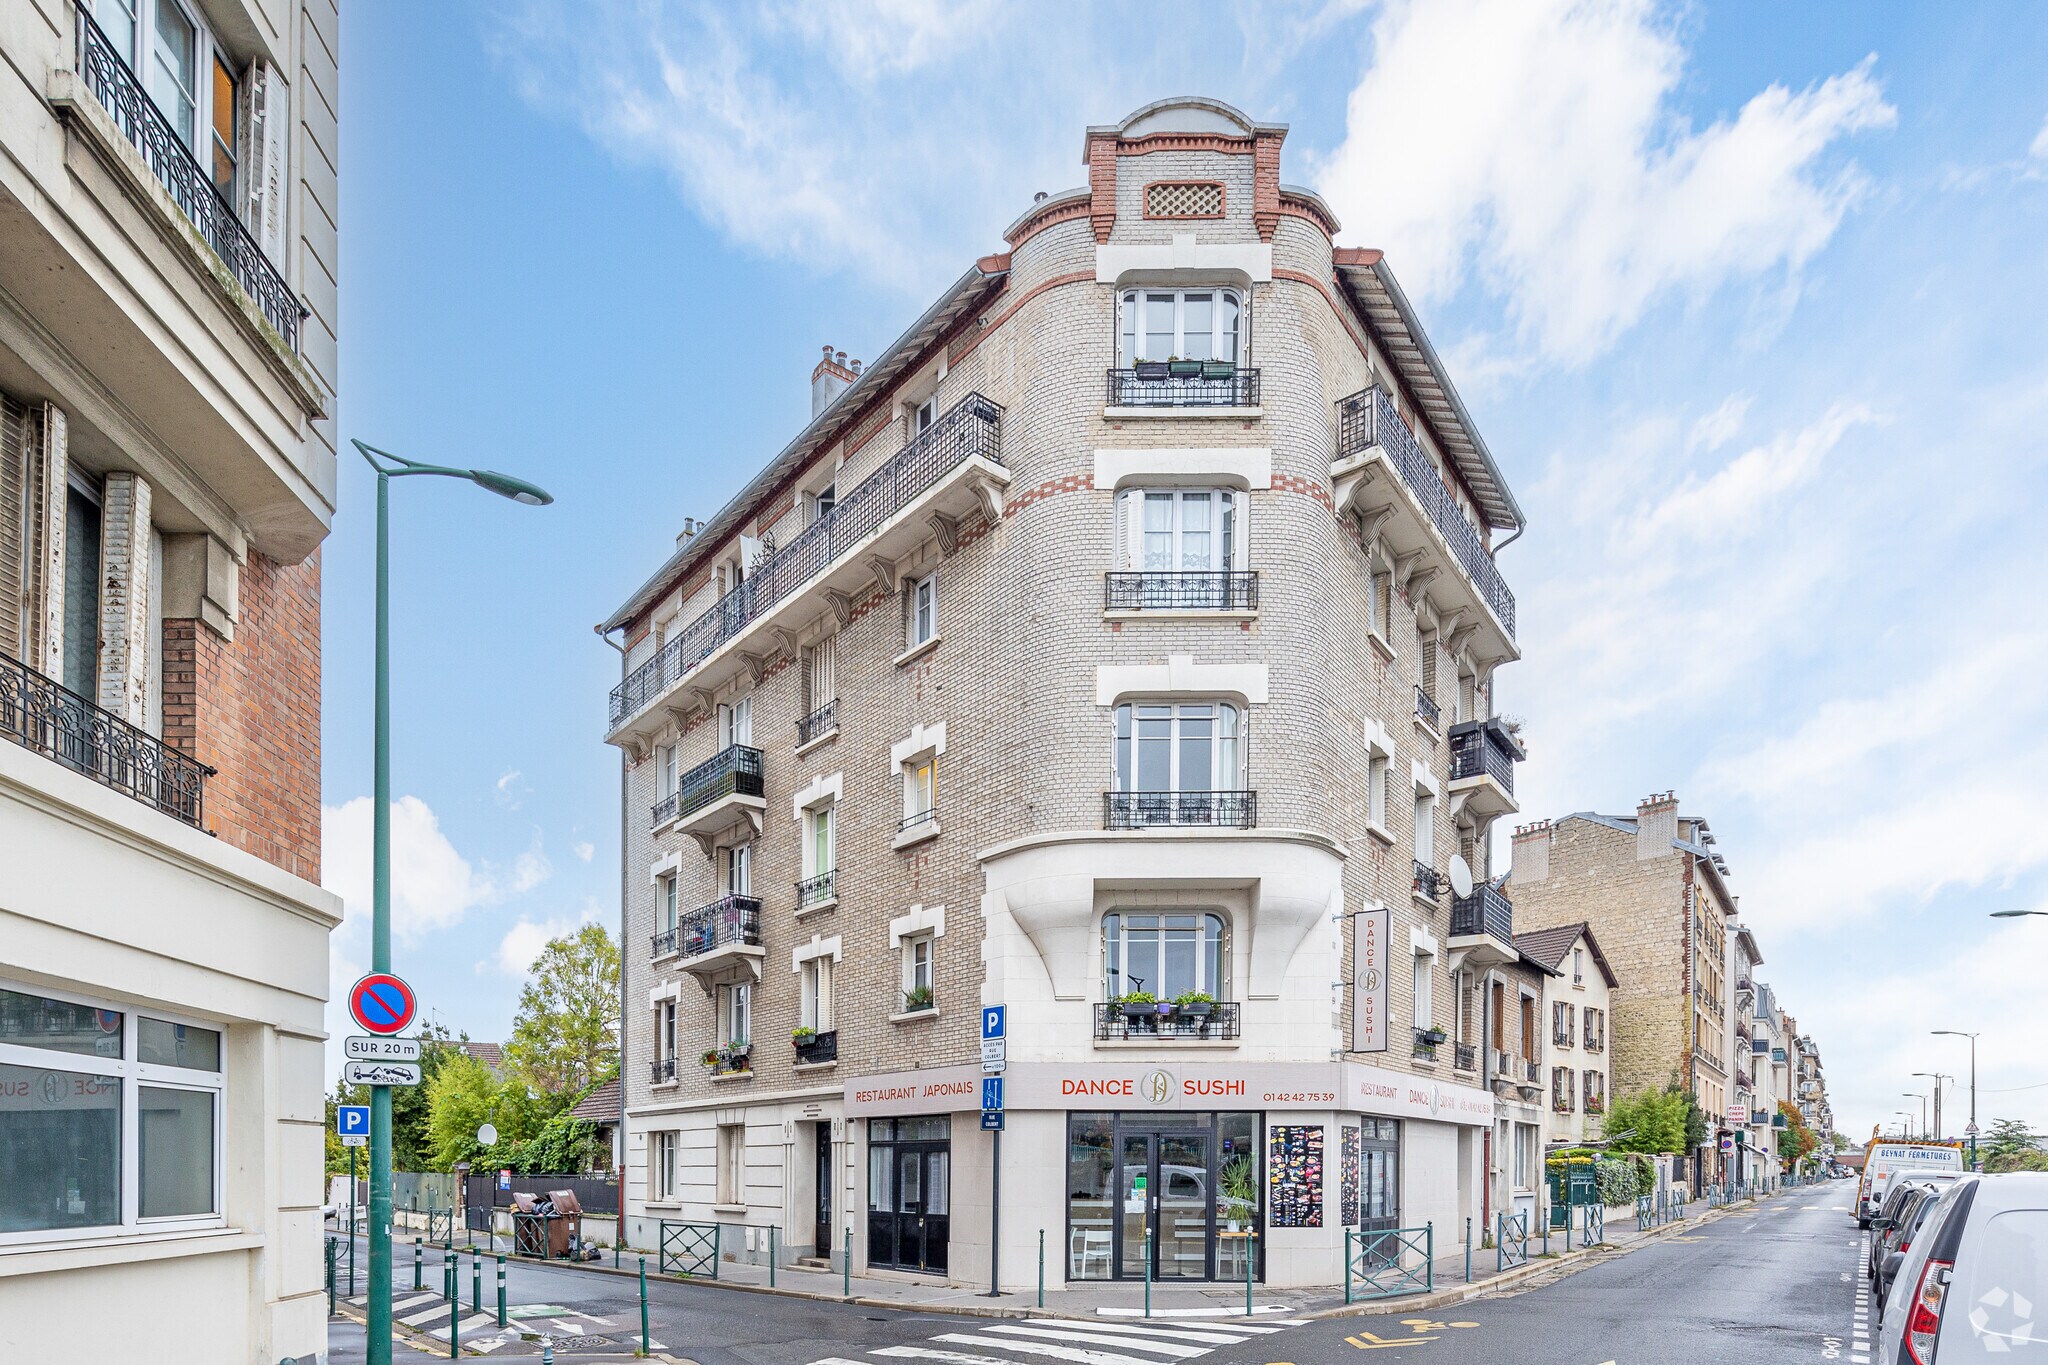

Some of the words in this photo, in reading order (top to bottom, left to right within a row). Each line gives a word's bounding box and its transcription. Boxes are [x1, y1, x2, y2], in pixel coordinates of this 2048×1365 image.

[1366, 920, 1375, 967] DANCE
[987, 1012, 999, 1033] P
[1365, 996, 1373, 1044] SUSHI
[351, 1042, 378, 1053] SUR
[384, 1044, 401, 1054] 20
[403, 1046, 415, 1055] m
[856, 1086, 917, 1103] RESTAURANT
[922, 1081, 974, 1098] JAPONAIS
[1062, 1079, 1134, 1095] DANCE
[1183, 1079, 1246, 1096] SUSHI
[1277, 1093, 1290, 1102] 42
[1292, 1093, 1305, 1102] 42
[1307, 1093, 1320, 1102] 75
[1322, 1093, 1335, 1102] 39
[1360, 1082, 1398, 1099] RESTAURANT
[1409, 1089, 1429, 1106] DANCE
[347, 1111, 362, 1131] P
[1881, 1149, 1906, 1158] BEYNAT
[1908, 1151, 1952, 1161] FERMETURES
